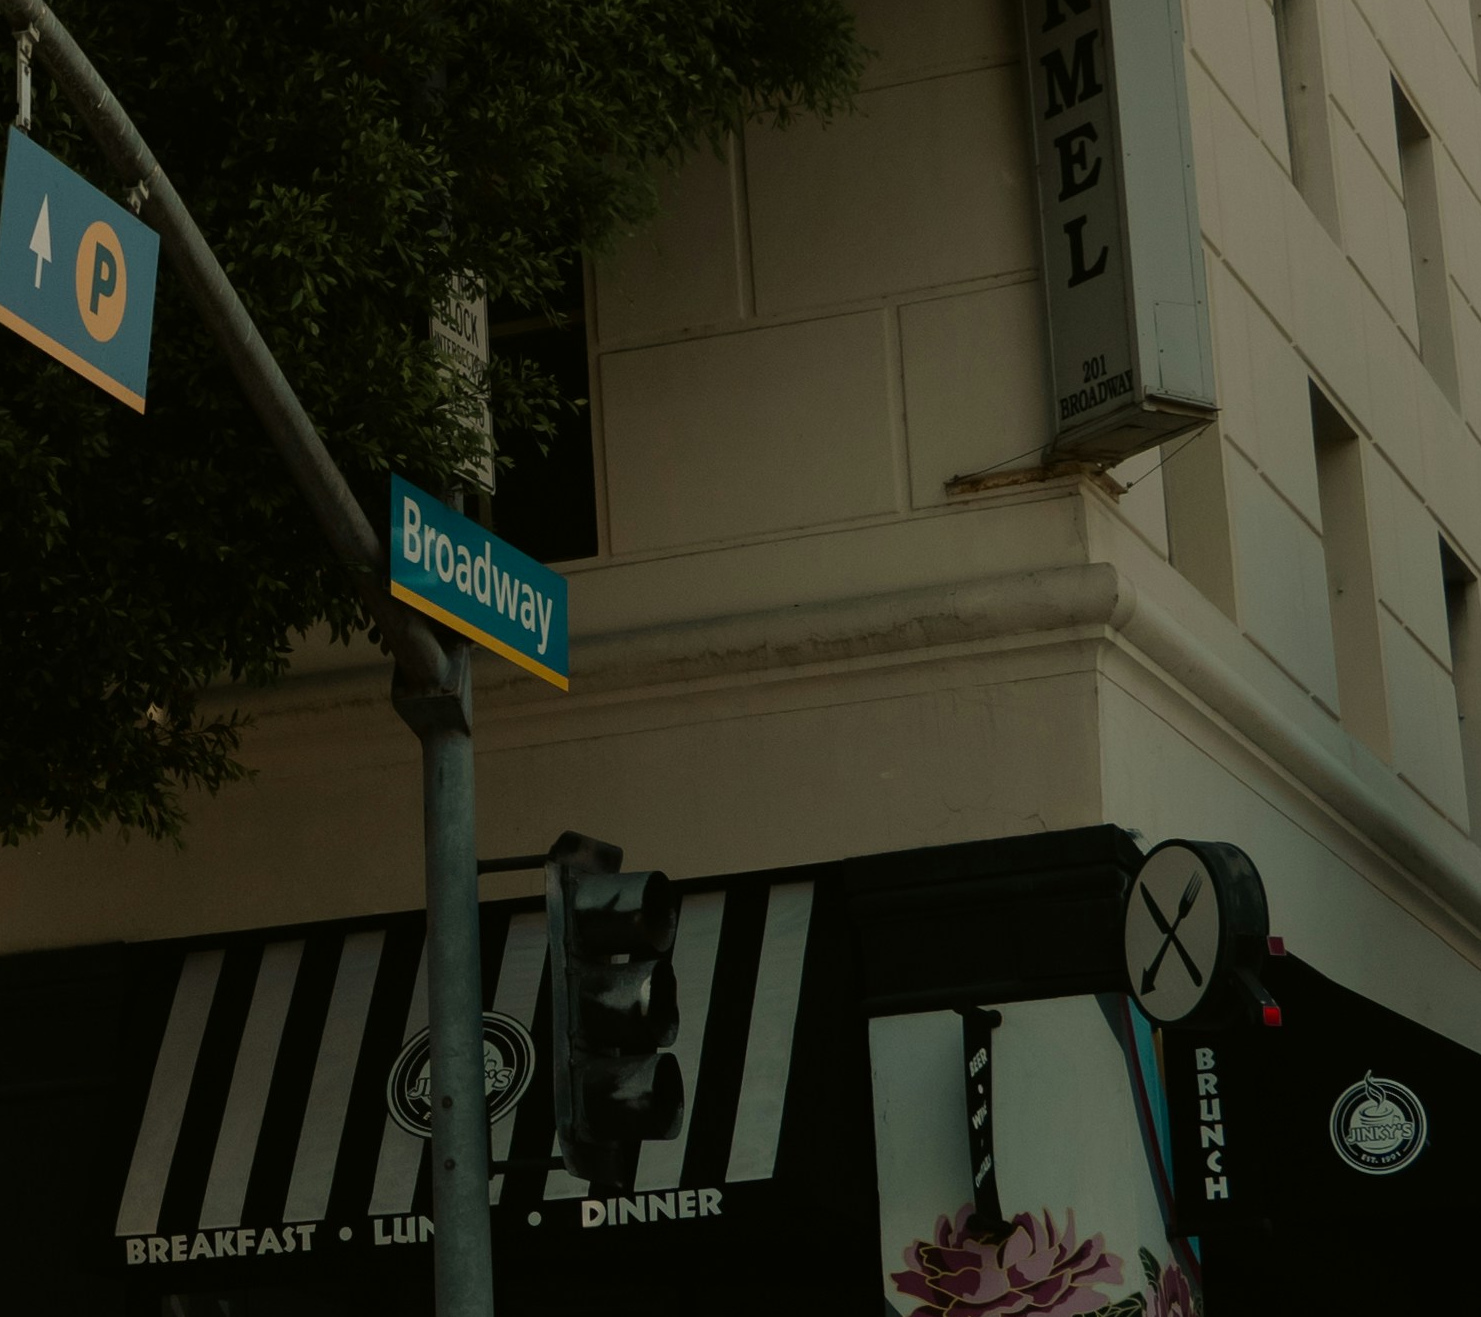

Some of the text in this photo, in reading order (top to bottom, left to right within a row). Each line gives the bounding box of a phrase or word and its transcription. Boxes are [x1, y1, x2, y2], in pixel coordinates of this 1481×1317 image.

[89, 240, 118, 316] P
[1060, 368, 1134, 420] BROADWAY
[1082, 354, 1107, 383] 201
[402, 495, 554, 656] Broadway
[1194, 1046, 1229, 1201] BRUNCH
[1346, 1122, 1414, 1144] JINKY'S
[125, 1187, 724, 1265] BREAKFAST LUN DINNER
